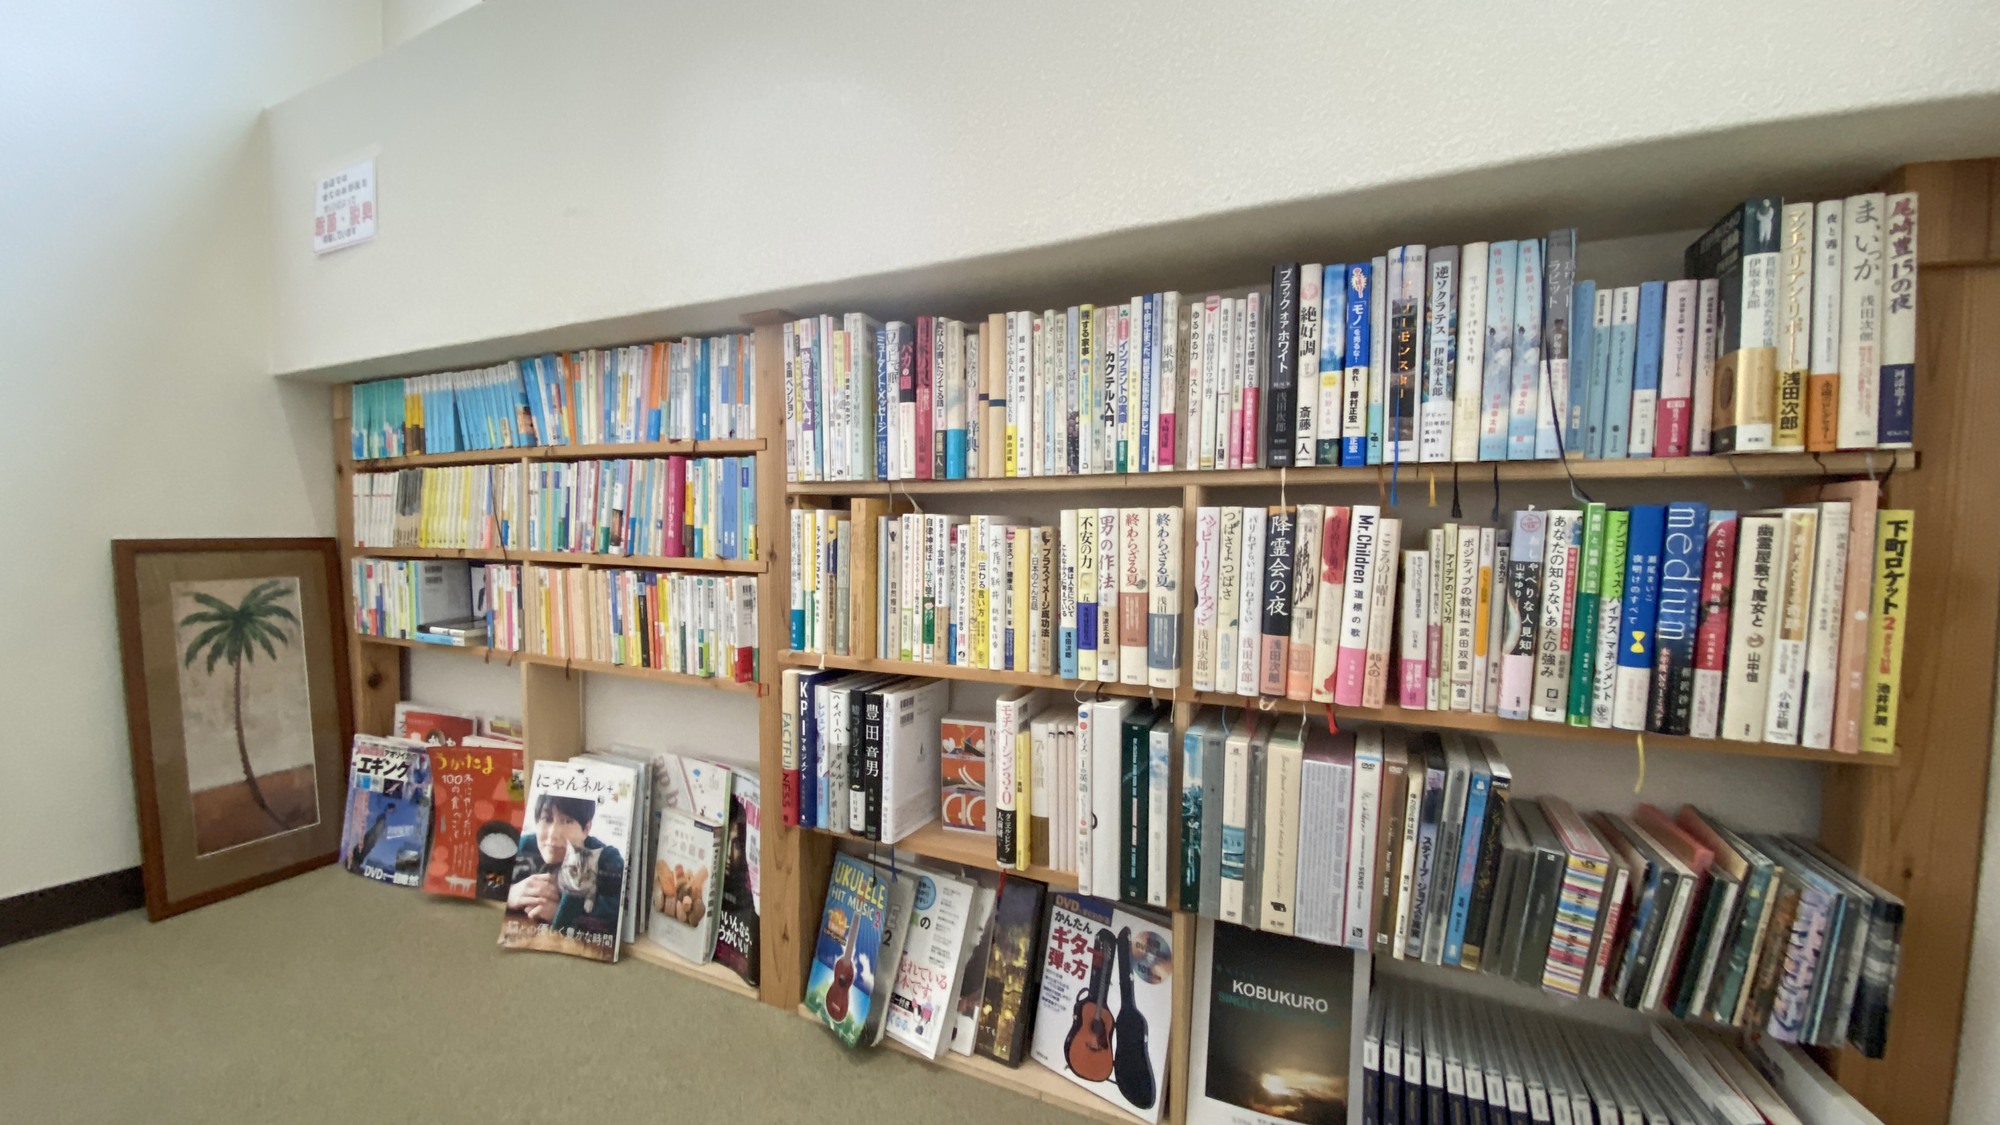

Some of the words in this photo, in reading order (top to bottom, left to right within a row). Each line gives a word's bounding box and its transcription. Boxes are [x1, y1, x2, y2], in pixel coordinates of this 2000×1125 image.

[1825, 213, 1838, 250] 夜と霧
[1854, 199, 1883, 288] ま、いっか。
[1888, 197, 1915, 316] 尾崎豊15の夜
[1434, 265, 1450, 335] 逆ソクラテス
[1493, 247, 1508, 333] 残り全部バケーショ
[1522, 246, 1537, 333] 残り全部バケーショ
[1547, 259, 1562, 309] ラビット
[1747, 257, 1762, 310] 伊坂幸太郎
[1190, 311, 1200, 361] ゆるめる力
[1299, 306, 1317, 356] 絶好調
[1859, 295, 1875, 342] 浅田次郎
[785, 361, 794, 420] 全国ペンション
[1104, 351, 1116, 428] カクテル入門
[1431, 346, 1445, 397] 伊坂幸太郎
[1516, 373, 1532, 415] 伊坂幸太郎
[1275, 391, 1287, 432] 浅田次郎
[1487, 392, 1502, 435] 伊坂幸太郎
[1780, 371, 1800, 431] 浅田次郎
[1298, 406, 1312, 456] 斎藤一人
[1080, 516, 1094, 569] 不安の力
[1099, 516, 1116, 590] 男の作法
[1125, 513, 1140, 588] 終わらざる夏
[1156, 513, 1171, 588] 終わらざる夏
[1220, 512, 1236, 602] つばさよつばさ
[1266, 514, 1293, 617] 降霊会の夜
[1353, 514, 1375, 584] Mr.Children
[978, 562, 987, 617] 伝わる言い方
[991, 537, 1001, 600] 本屋の新井
[1067, 566, 1075, 617] 僕は人生について
[1375, 533, 1391, 608] こころの日曜日
[1443, 553, 1455, 625] アイデアのつくり方
[1459, 538, 1475, 624] ポジティブの教科
[1513, 563, 1525, 599] 山本ゆり
[1628, 553, 1643, 624] 夜明けのすべて
[1657, 506, 1701, 640] medium
[1751, 524, 1774, 628] 幽霊屋敷で魔女と
[1518, 535, 1539, 656] おしゃべりな人見知
[1064, 631, 1073, 659] 浅田次郎
[1102, 610, 1111, 645] 池波正太郎
[1197, 630, 1209, 671] 浅田次郎
[1457, 628, 1470, 671] 武田双雲
[1241, 637, 1254, 684] 浅田次郎
[1267, 638, 1281, 683] 浅田次郎
[1367, 653, 1382, 678] 45人の
[800, 681, 809, 737] KPI
[1776, 690, 1792, 732] 小林正観
[1873, 682, 1891, 728] 池井戸潤
[356, 757, 411, 779] エギング
[434, 752, 495, 779] うかたま
[1000, 705, 1014, 805] モチベーション3.0
[1361, 762, 1376, 771] DVD
[536, 774, 615, 794] にゃんネル+
[833, 860, 886, 910] UKULELE
[1357, 866, 1366, 890] SENSE
[1382, 876, 1391, 897] SENSE
[830, 886, 848, 902] HIT
[847, 897, 874, 921] MUSIC
[873, 911, 881, 929] 2
[919, 915, 932, 930] の
[1053, 911, 1094, 935] かんたん
[1055, 895, 1081, 913] DVD
[882, 929, 893, 947] 2
[1051, 927, 1105, 970] ギター
[1046, 947, 1090, 982] 弾き方
[1232, 979, 1329, 1013] KOBUKURO
